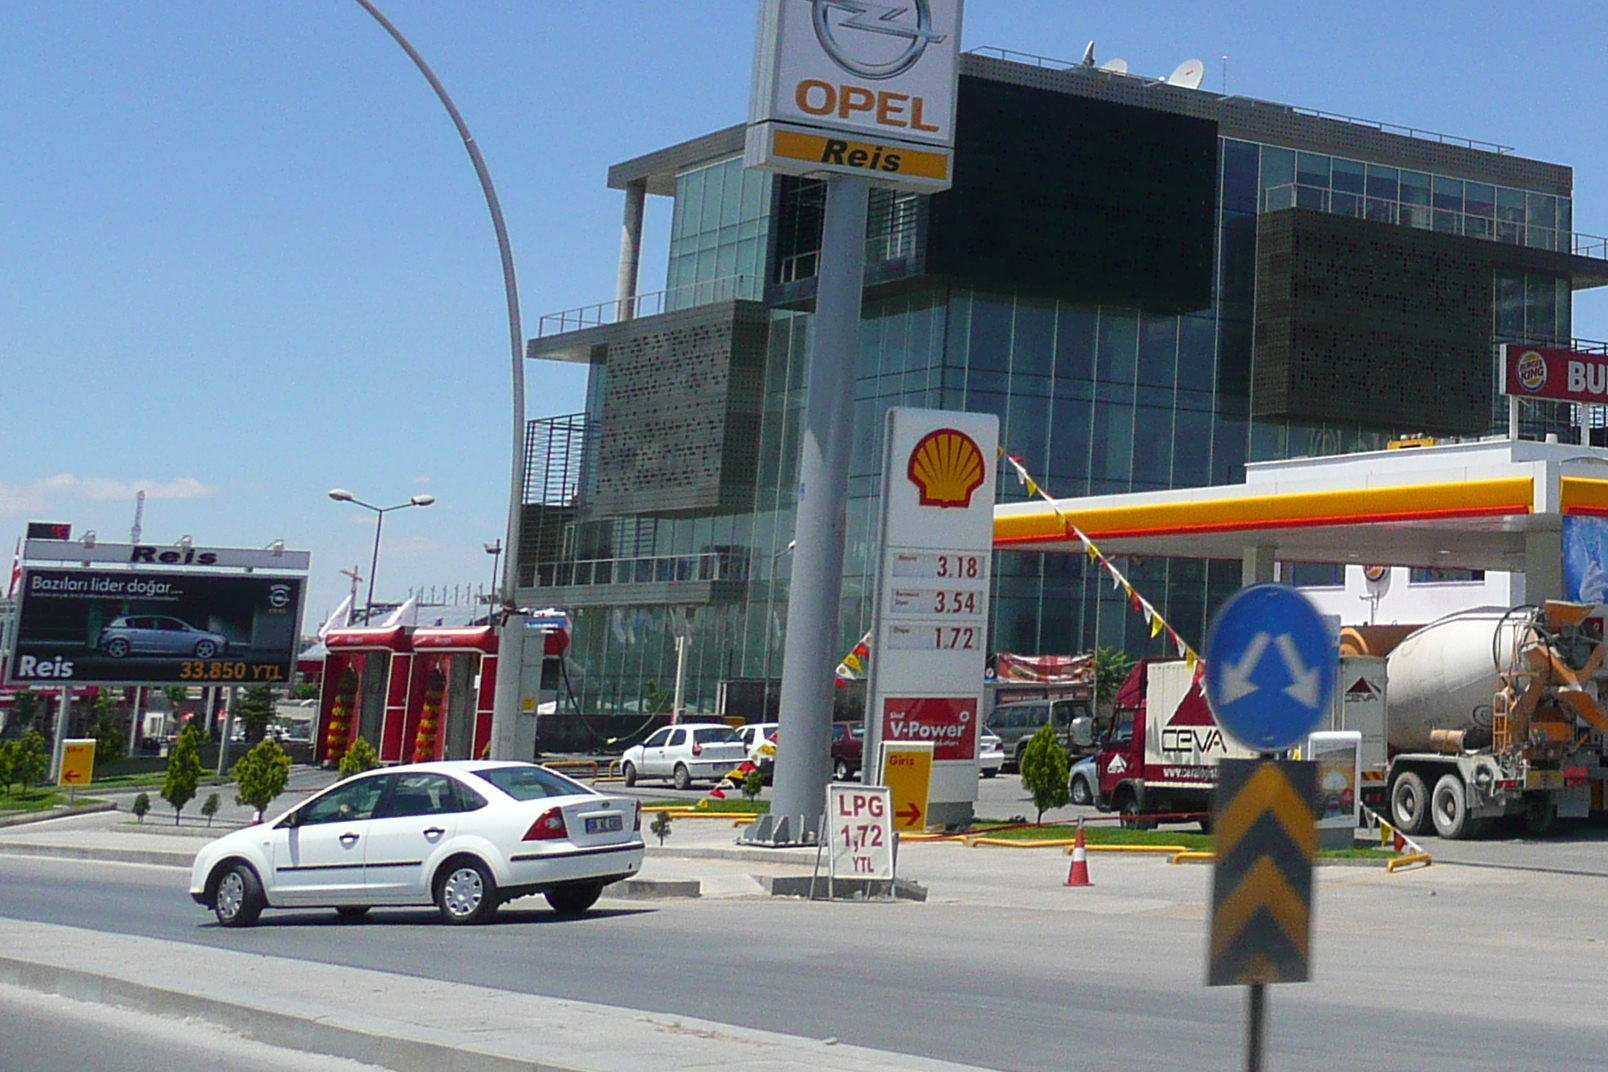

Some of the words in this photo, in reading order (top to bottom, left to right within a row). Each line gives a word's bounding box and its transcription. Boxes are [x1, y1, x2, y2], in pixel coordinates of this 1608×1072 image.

[795, 78, 940, 133] OPEL
[820, 138, 901, 173] Reis
[1521, 368, 1545, 380] KING
[130, 546, 218, 566] Reis
[937, 555, 977, 578] 3.18
[31, 576, 89, 592] Bazıları
[91, 577, 124, 593] lider
[934, 591, 975, 614] 3.54
[935, 627, 974, 649] 1.72
[19, 655, 74, 678] Reis
[179, 661, 247, 680] 33.850
[252, 665, 284, 680] YTL
[890, 721, 966, 738] V-Power
[1162, 729, 1227, 753] CEVA
[839, 794, 884, 817] LPG
[841, 824, 883, 853] 1,72
[852, 856, 875, 873] YTL
